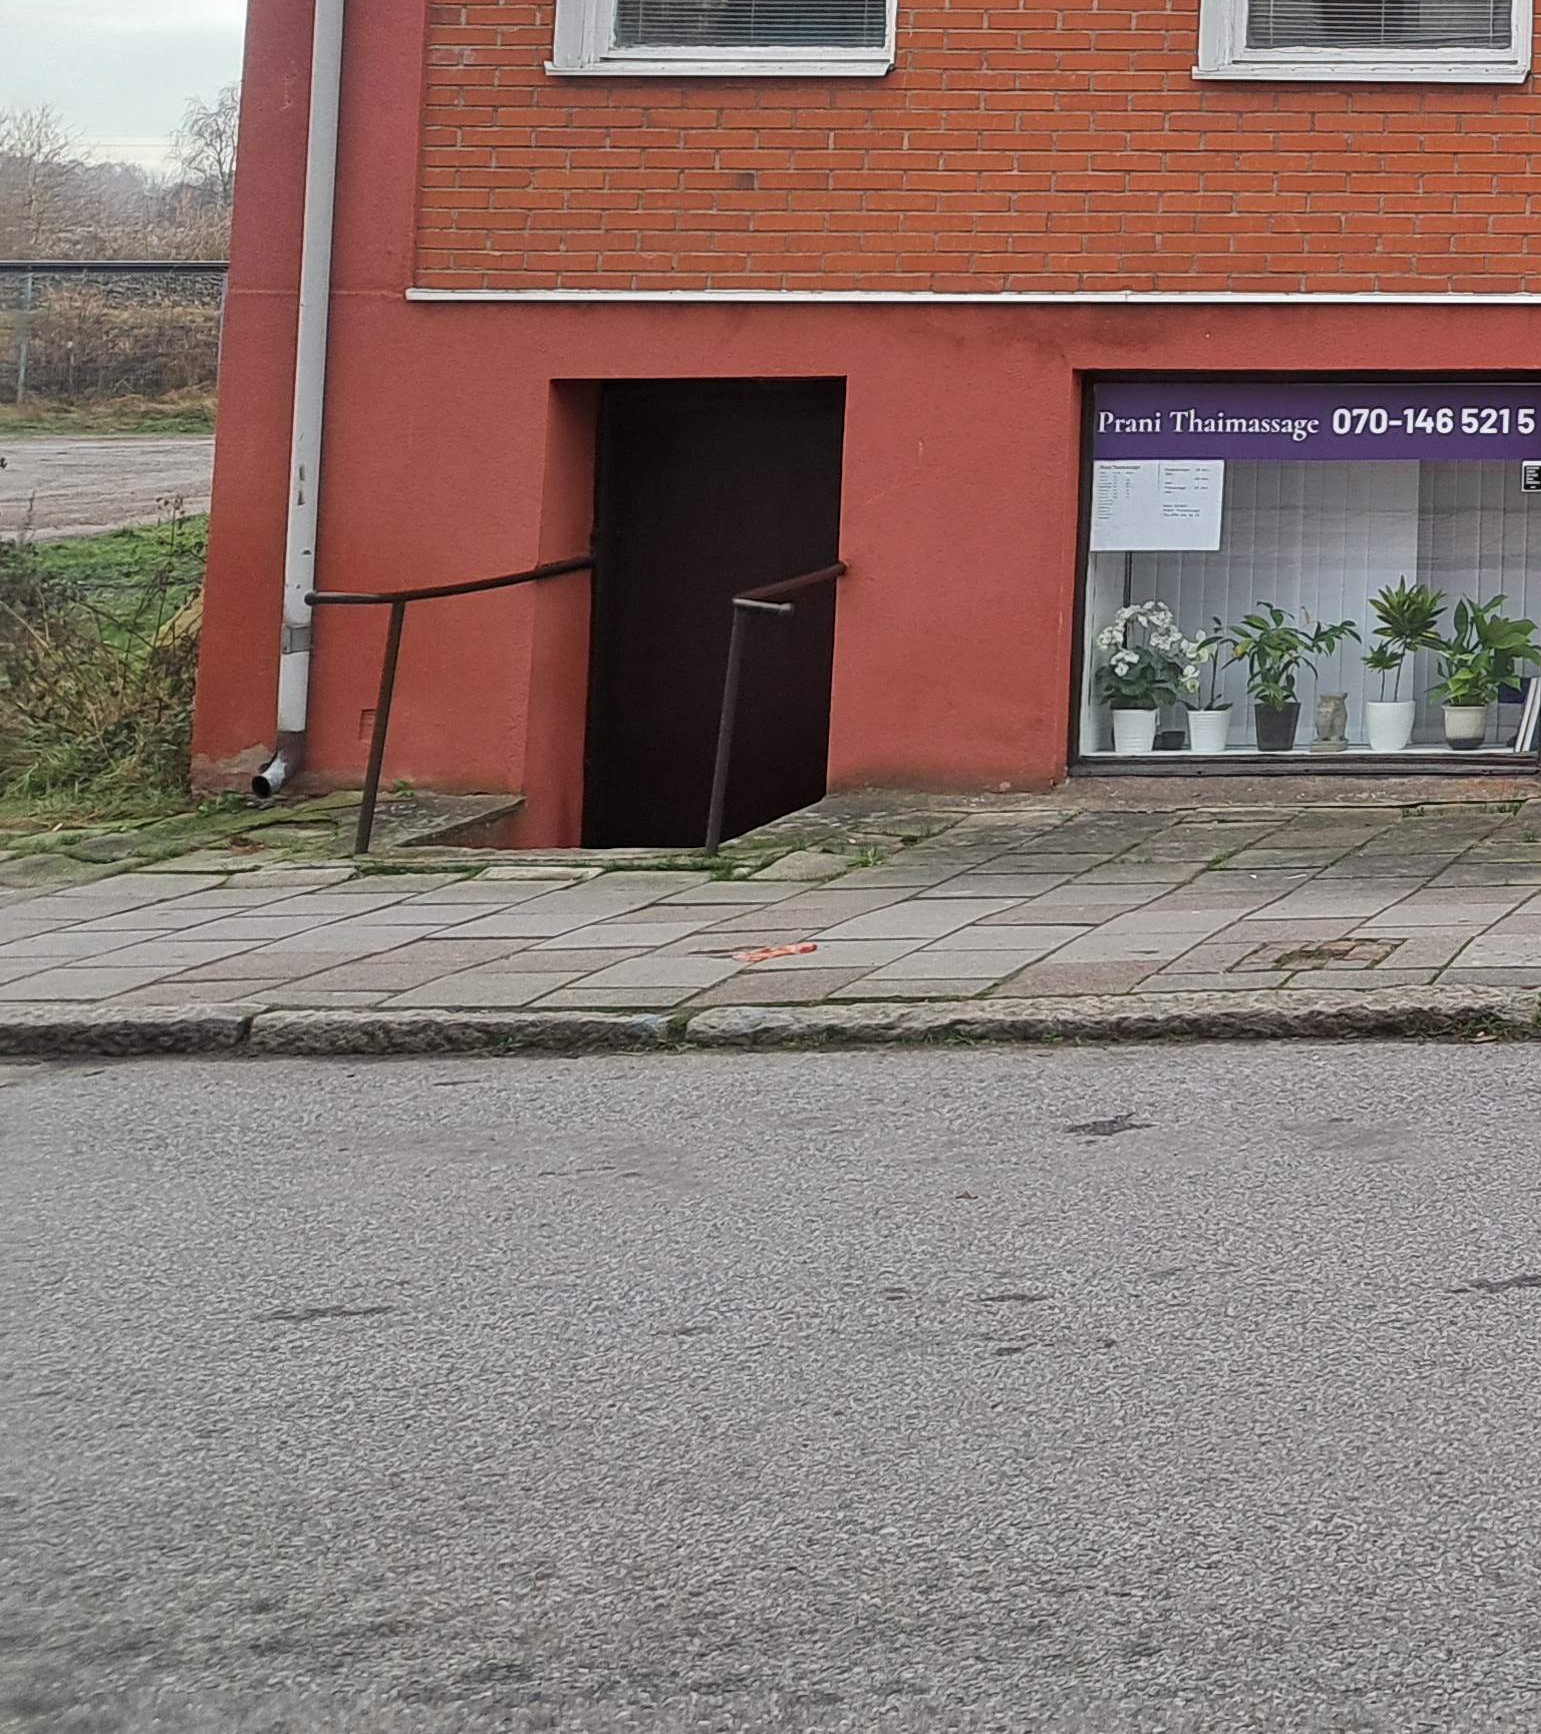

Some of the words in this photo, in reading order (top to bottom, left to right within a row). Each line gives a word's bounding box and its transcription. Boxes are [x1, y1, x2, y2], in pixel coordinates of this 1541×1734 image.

[1098, 410, 1162, 433] Prani
[1169, 408, 1320, 442] Thaimassage
[1332, 408, 1454, 434] 070-146
